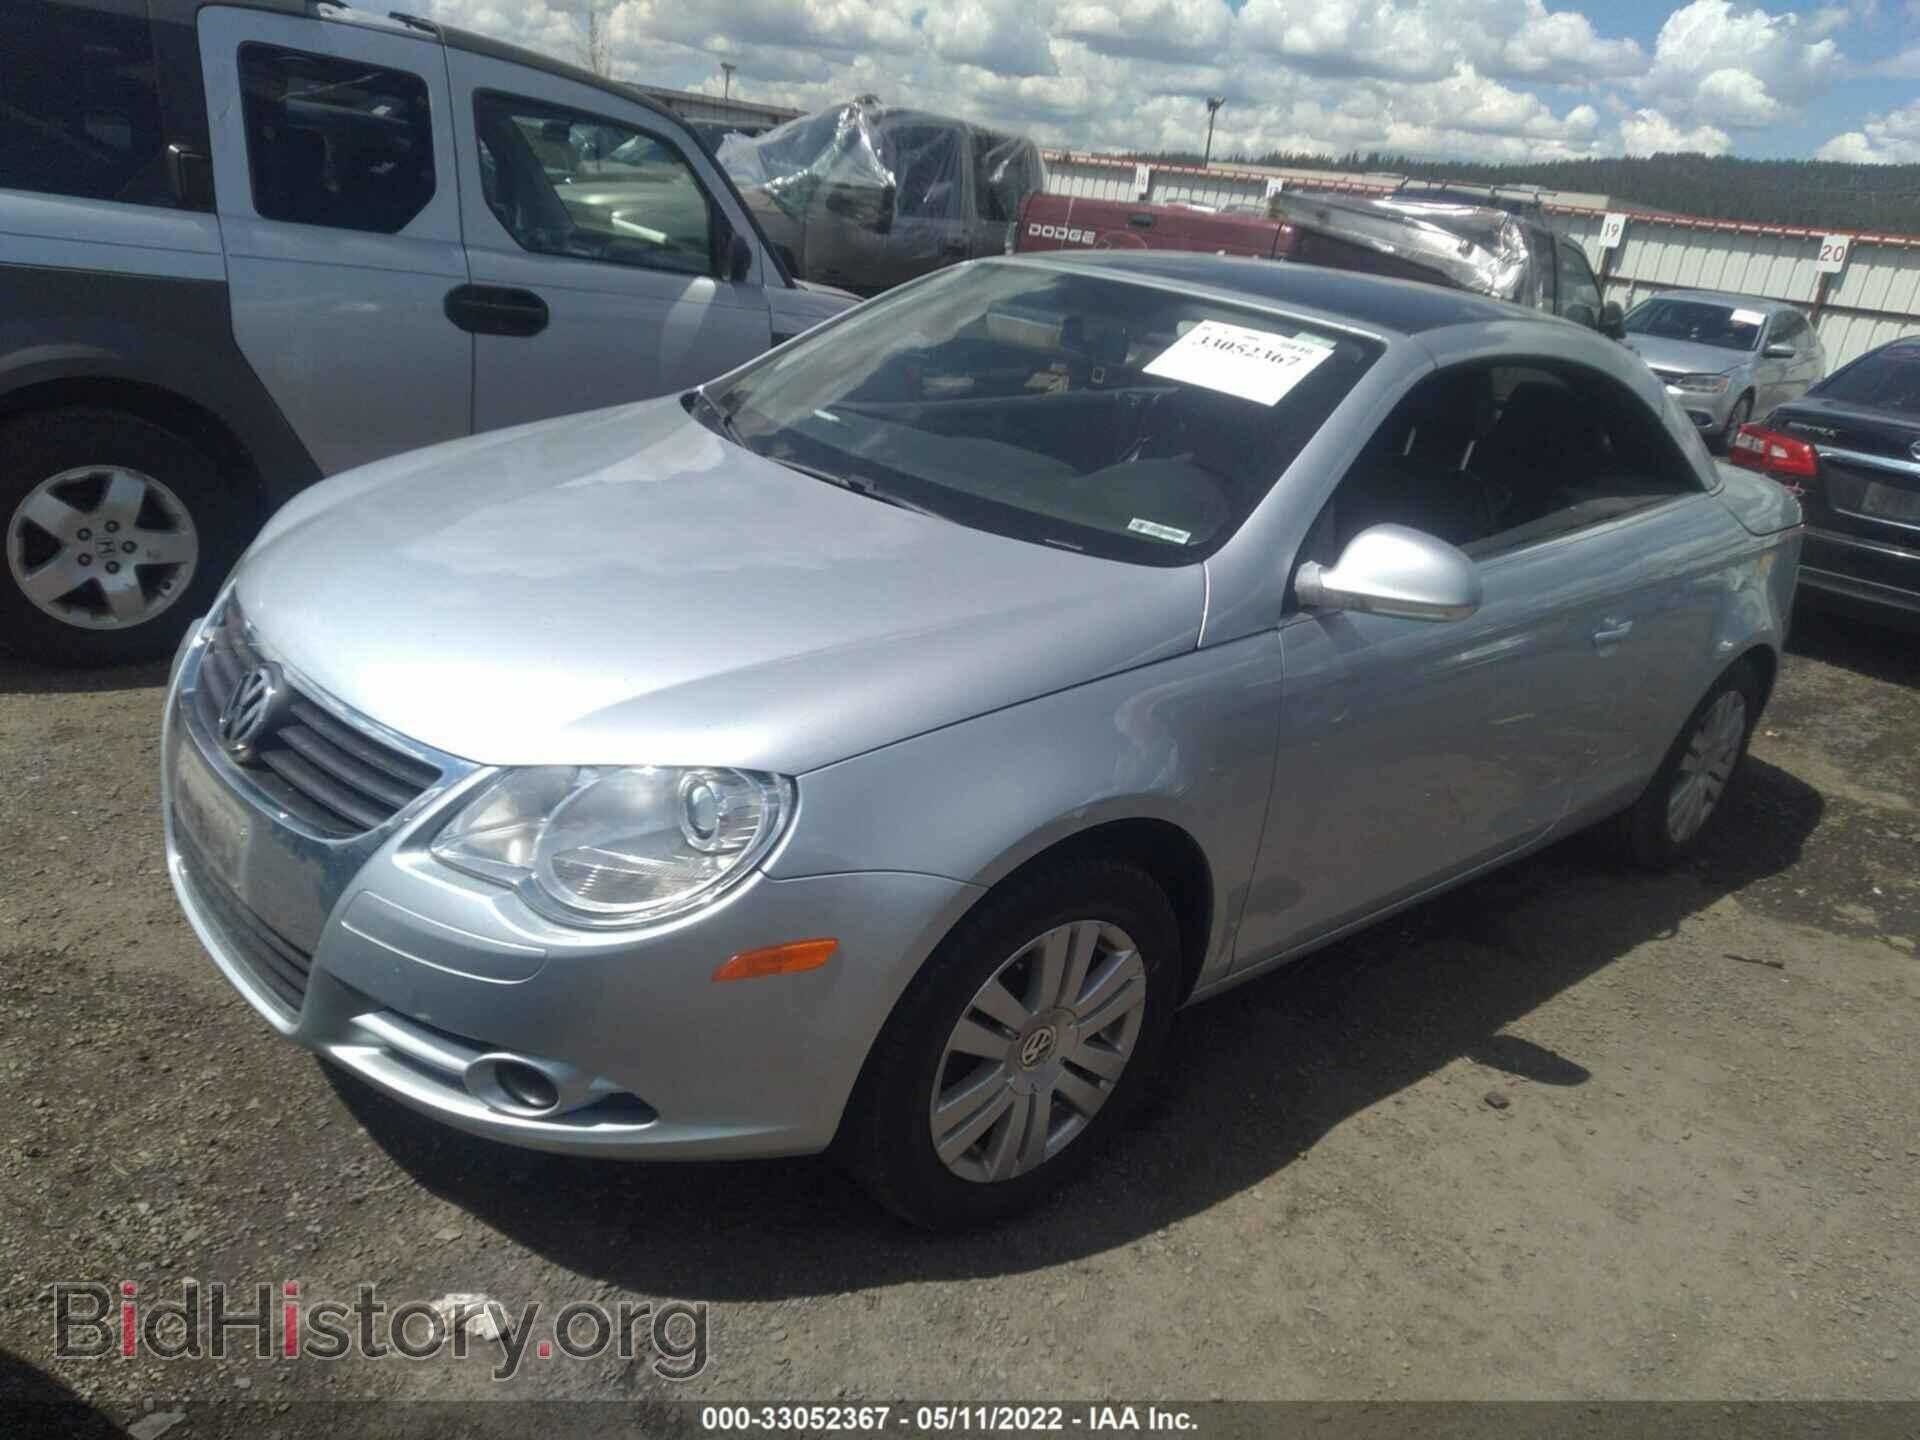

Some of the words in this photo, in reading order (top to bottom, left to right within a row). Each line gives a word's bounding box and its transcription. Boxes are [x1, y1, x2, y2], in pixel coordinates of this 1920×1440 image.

[1028, 223, 1096, 245] DODGE
[1605, 223, 1620, 238] 19
[1820, 244, 1845, 263] 20
[1191, 335, 1303, 368] 33052367
